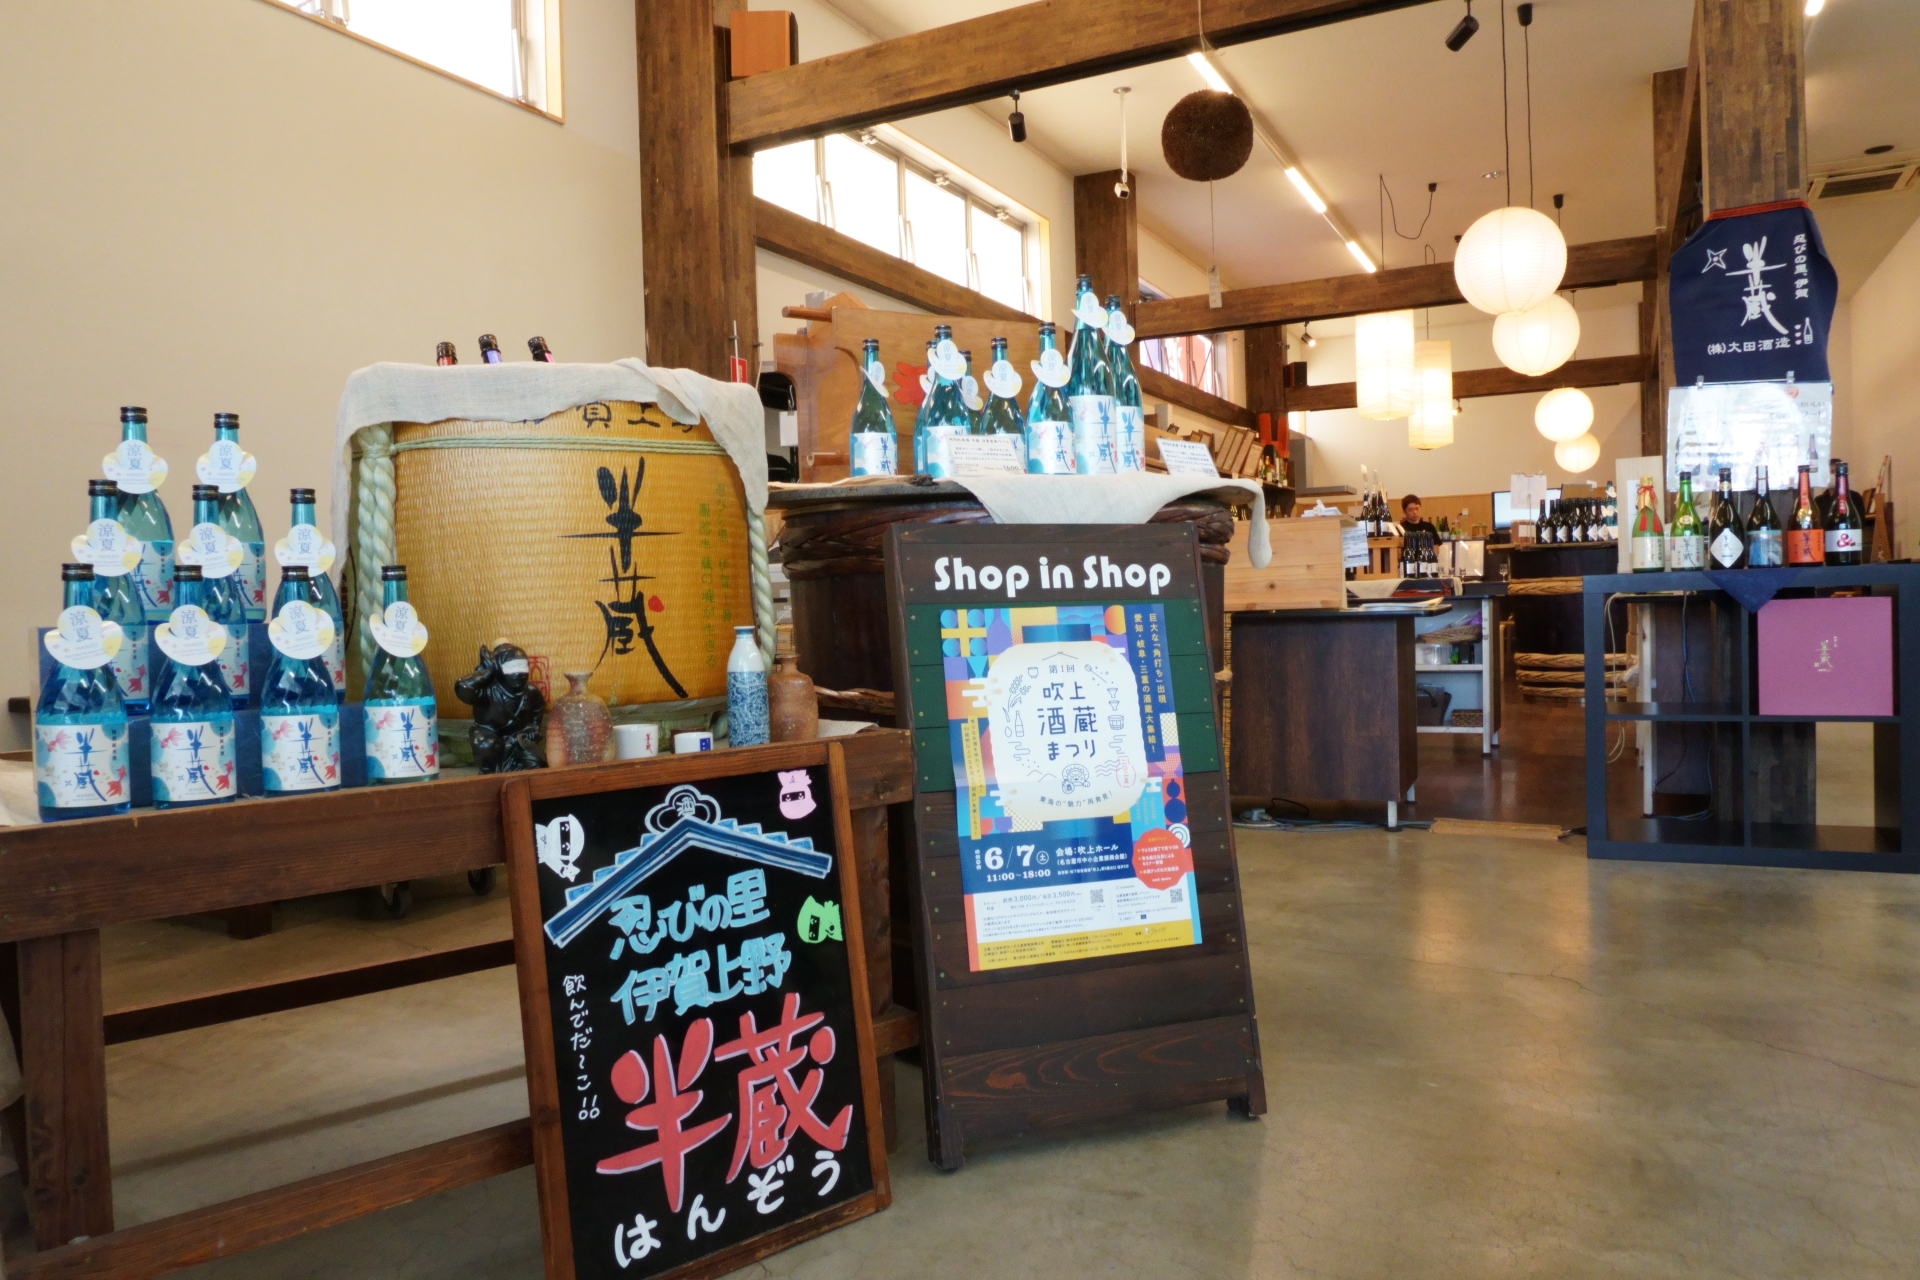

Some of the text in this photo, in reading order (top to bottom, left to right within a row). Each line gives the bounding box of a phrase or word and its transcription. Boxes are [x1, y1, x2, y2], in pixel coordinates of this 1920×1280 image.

[1726, 236, 1789, 334] 半蔵
[98, 523, 115, 553] 涼夏
[199, 527, 220, 556] 涼夏
[297, 528, 312, 554] 涼夏
[555, 457, 689, 699] 半蔵
[934, 555, 1171, 598] Shop in Shop
[69, 611, 93, 643] 涼夏
[181, 609, 199, 640] 涼夏
[288, 605, 309, 635] 涼夏
[393, 605, 410, 634] 涼夏
[1048, 664, 1075, 674] 第1回
[1149, 614, 1167, 703] 巨大な「角打ち」出現
[1043, 681, 1086, 700] 吹上
[386, 709, 426, 773] 半蔵
[1037, 706, 1098, 735] 酒蔵
[62, 728, 107, 802] 半蔵
[175, 725, 217, 796] 半蔵
[286, 718, 325, 784] 半蔵
[1047, 739, 1096, 761] まつり
[607, 868, 770, 960] 忍びの里
[610, 932, 792, 1025] 伊賀上野
[596, 992, 854, 1213] 半蔵
[614, 1150, 841, 1270] はんぞう
